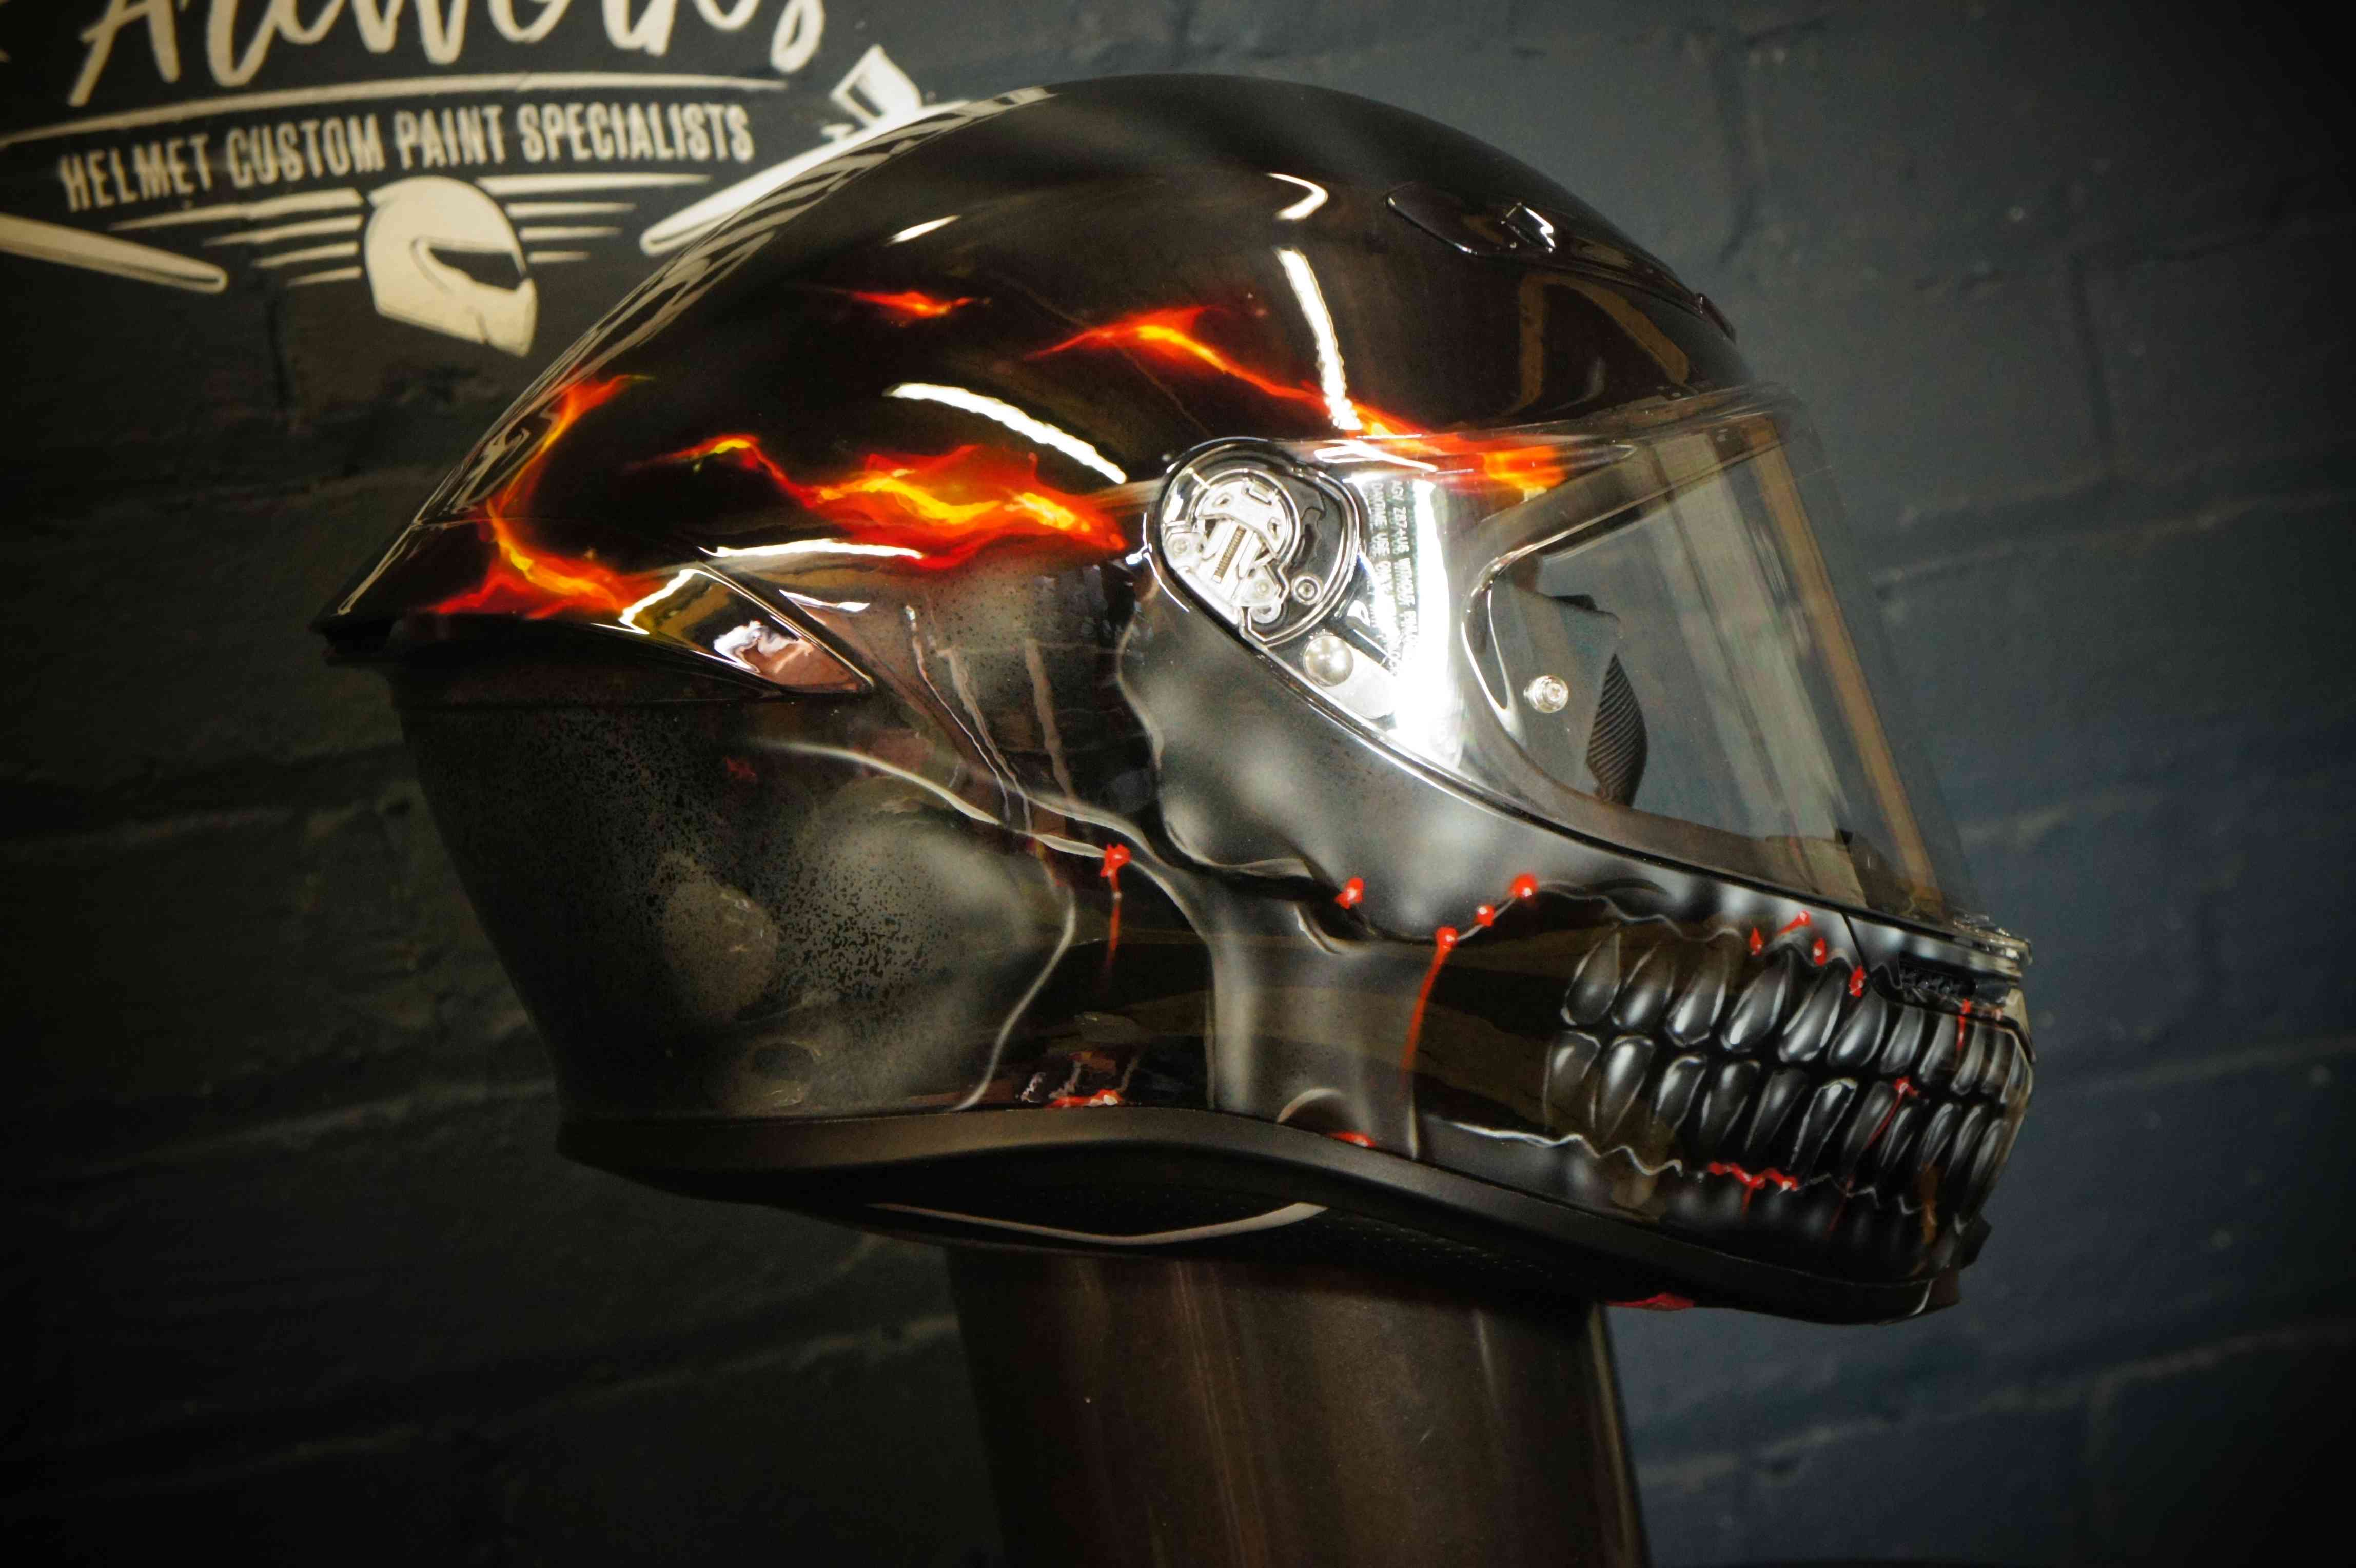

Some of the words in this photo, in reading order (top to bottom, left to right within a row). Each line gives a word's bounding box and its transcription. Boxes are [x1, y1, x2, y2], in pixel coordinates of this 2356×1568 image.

[57, 134, 212, 212] HELMET
[225, 113, 385, 190] CUSTOM
[393, 104, 506, 171] PAINT
[517, 102, 753, 163] SPECIALISTS
[1371, 483, 1388, 527] DAYTIME
[1391, 480, 1404, 501] AGV
[1372, 533, 1390, 556] USE
[1397, 557, 1416, 605] WITHOUT
